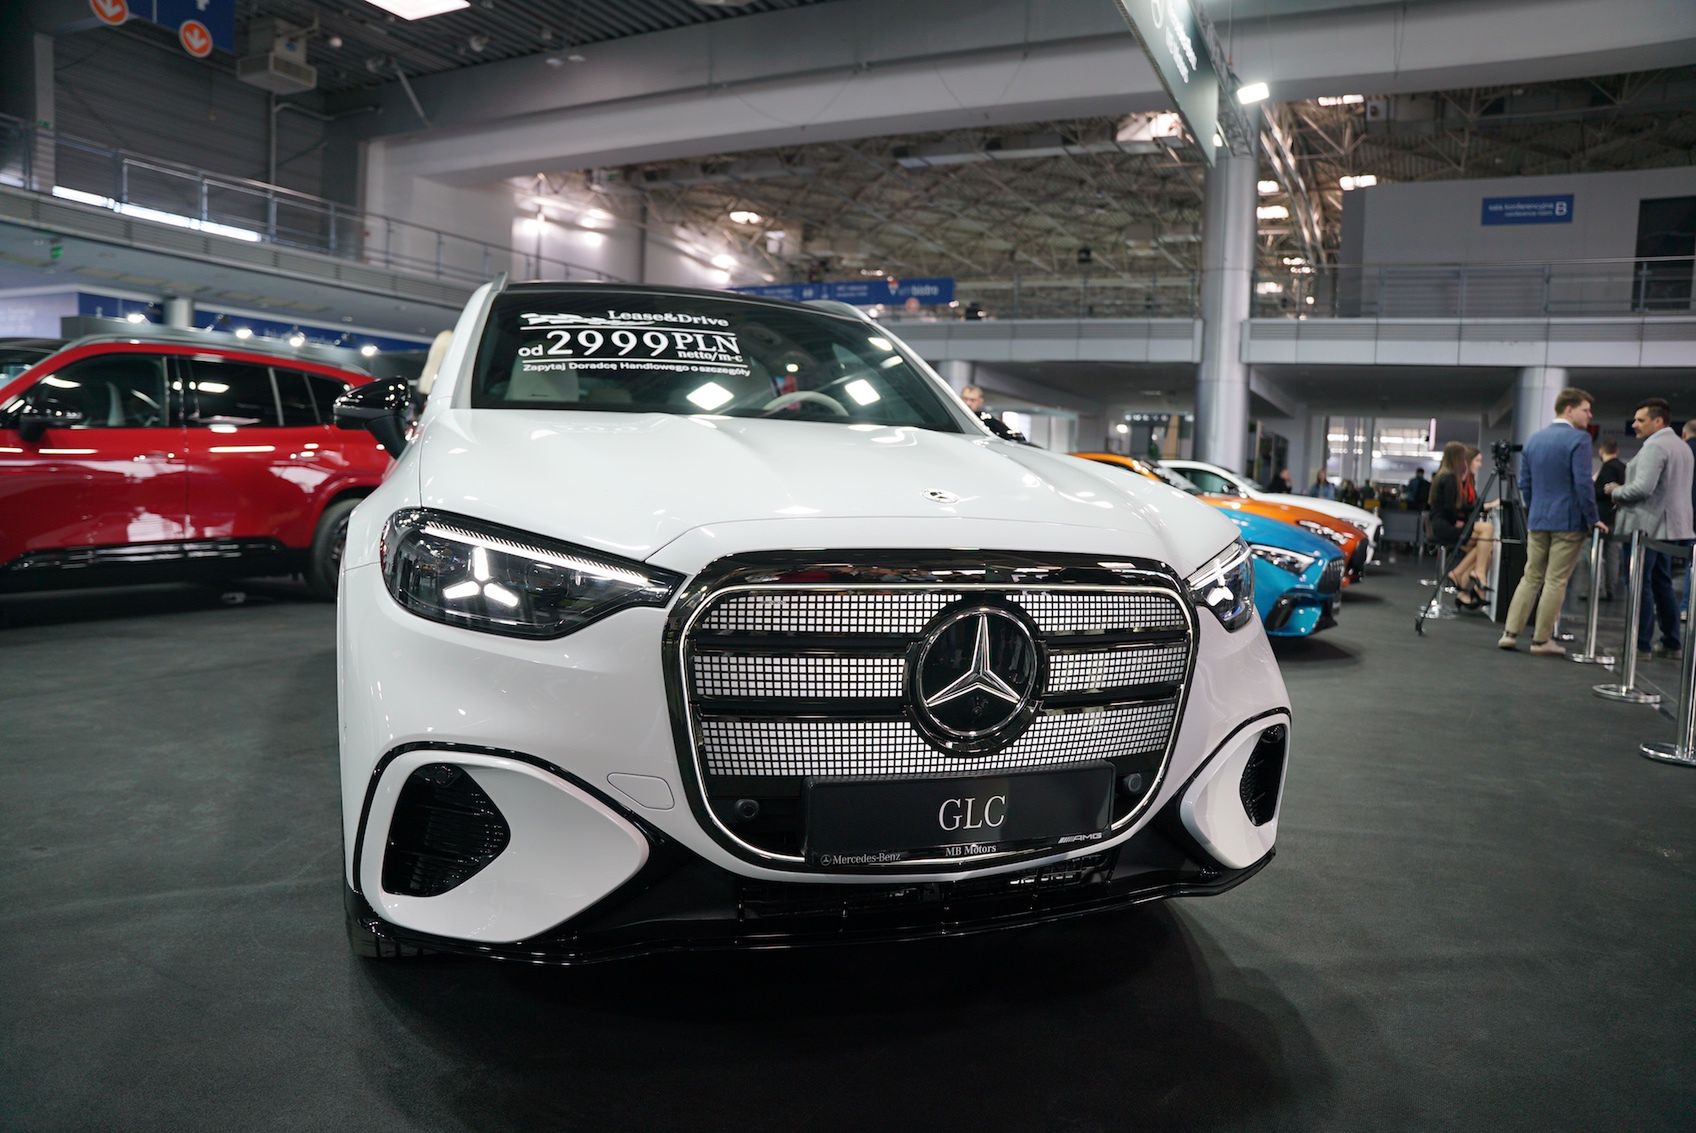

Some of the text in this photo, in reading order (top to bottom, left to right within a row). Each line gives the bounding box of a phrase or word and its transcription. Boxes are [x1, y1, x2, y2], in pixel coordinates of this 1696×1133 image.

[1555, 201, 1567, 216] B
[607, 310, 729, 327] Lease&Drive
[518, 330, 741, 357] od 2999 PLN
[677, 350, 743, 362] netto/m-c
[523, 363, 566, 372] Zapytaj
[568, 362, 618, 371] Doradcę
[620, 362, 690, 373] Handlowego
[699, 365, 751, 377] szczegóły
[938, 795, 1007, 831] GLC
[945, 844, 997, 857] MB Motors
[832, 852, 901, 865] Mercedes-Benz
